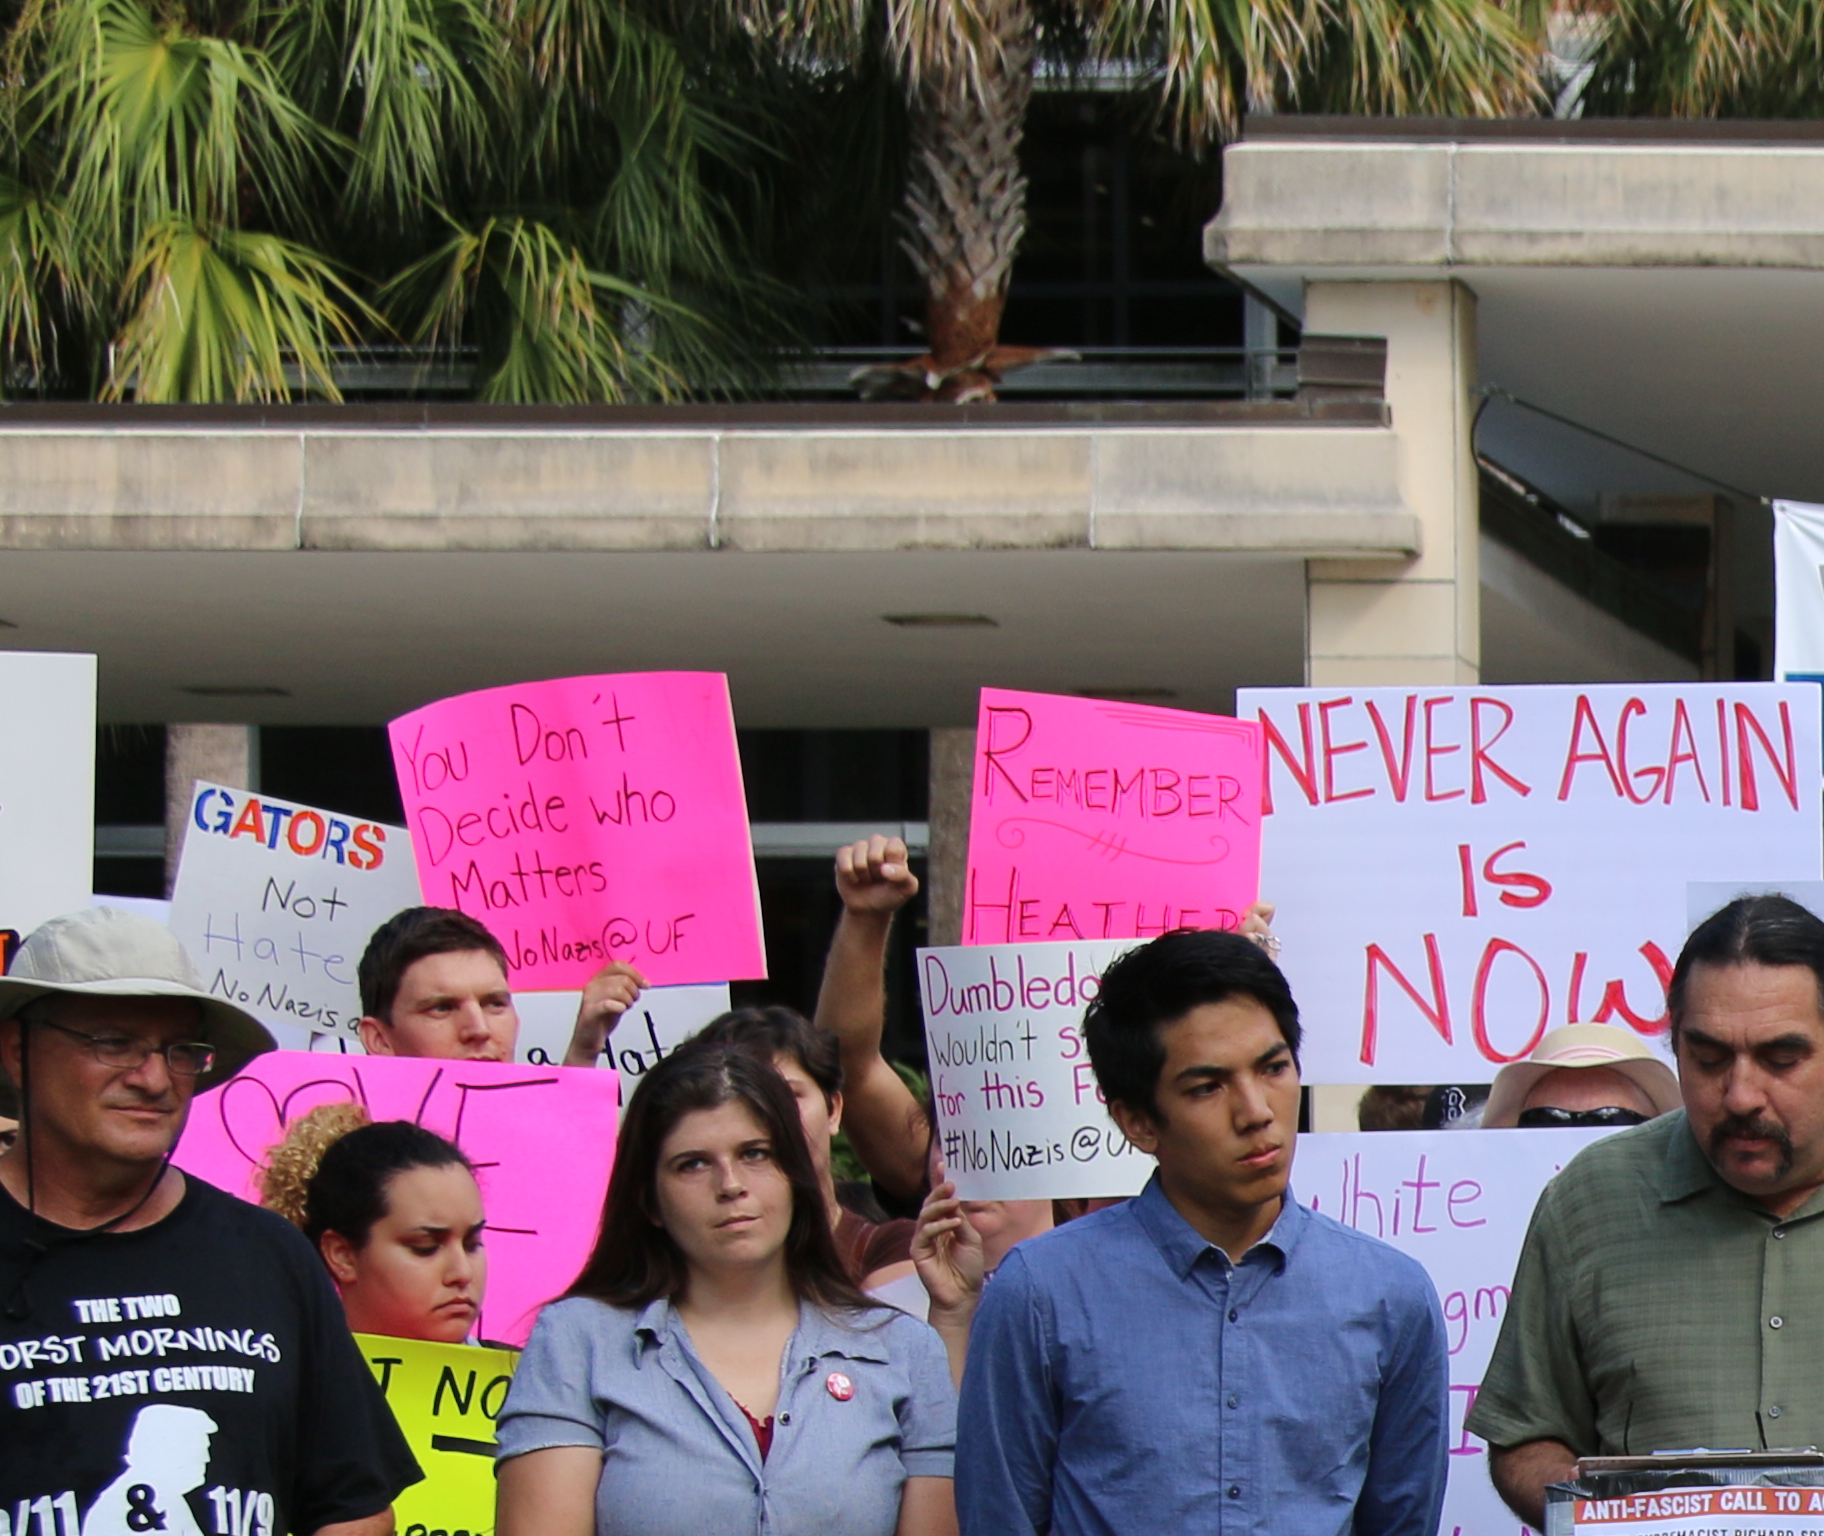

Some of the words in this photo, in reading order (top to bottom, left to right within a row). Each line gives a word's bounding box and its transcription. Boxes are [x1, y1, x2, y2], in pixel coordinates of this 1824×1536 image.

[399, 724, 469, 796] You
[509, 691, 637, 767] Don't
[1257, 694, 1532, 816] NEVER
[1557, 694, 1800, 812] AGAIN
[194, 787, 388, 871] GATORS
[417, 780, 569, 867] Decide
[261, 876, 350, 922] Not
[450, 849, 608, 913] Matters
[1456, 840, 1553, 918] IS
[203, 912, 354, 986] Hate
[1360, 932, 1677, 1068] NOW
[980, 1069, 1044, 1111] this
[74, 1298, 122, 1325] THE
[122, 1292, 182, 1322] TWO
[98, 1326, 282, 1364] MORNINGS
[14, 1380, 46, 1411] OF
[46, 1376, 92, 1404] THE
[91, 1369, 150, 1399] 21ST
[156, 1365, 257, 1394] CENTURY
[1581, 1493, 1713, 1522] ANTI-FASCIST
[1720, 1491, 1768, 1512] CALL
[1774, 1491, 1801, 1512] TO
